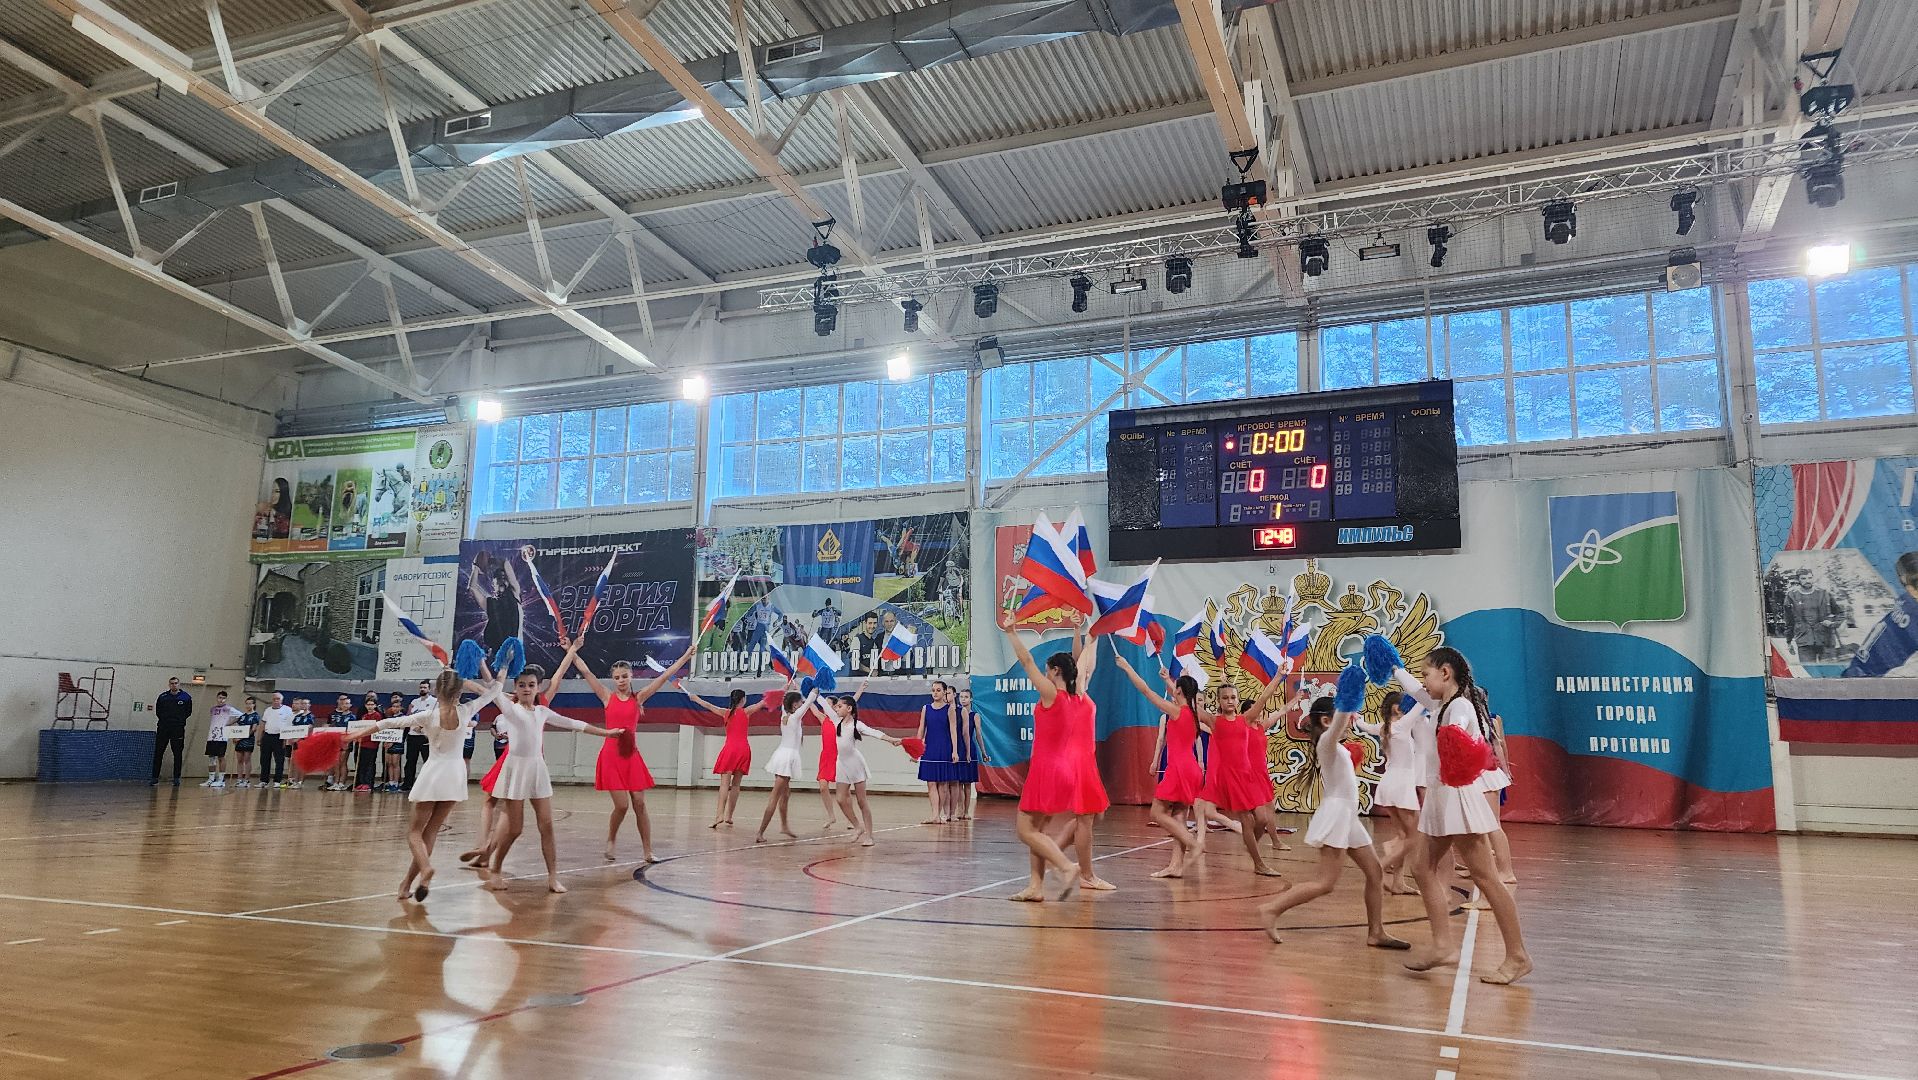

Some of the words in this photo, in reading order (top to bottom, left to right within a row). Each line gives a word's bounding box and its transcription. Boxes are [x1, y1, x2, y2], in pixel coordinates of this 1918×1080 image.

[1355, 412, 1385, 422] ВРЕМЯ
[1411, 407, 1441, 416] ФОЛЫ
[1237, 421, 1275, 432] ИГРОВОЕ
[1278, 419, 1307, 428] ВРЕМЯ
[1119, 432, 1145, 441] ФОЛЫ
[1181, 427, 1207, 436] ВРЕМЯ
[1259, 493, 1290, 502] ПЕРИОД
[537, 542, 642, 557] ТУРБОКОМПЛЕКТ
[825, 576, 861, 585] ПРОТВИНО
[702, 650, 771, 672] СПОНСОР
[1556, 676, 1694, 695] АДМИНИСТРАЦИЯ
[1596, 705, 1657, 724] ГОРОДА
[1589, 736, 1671, 754] ПРОТВИНО
